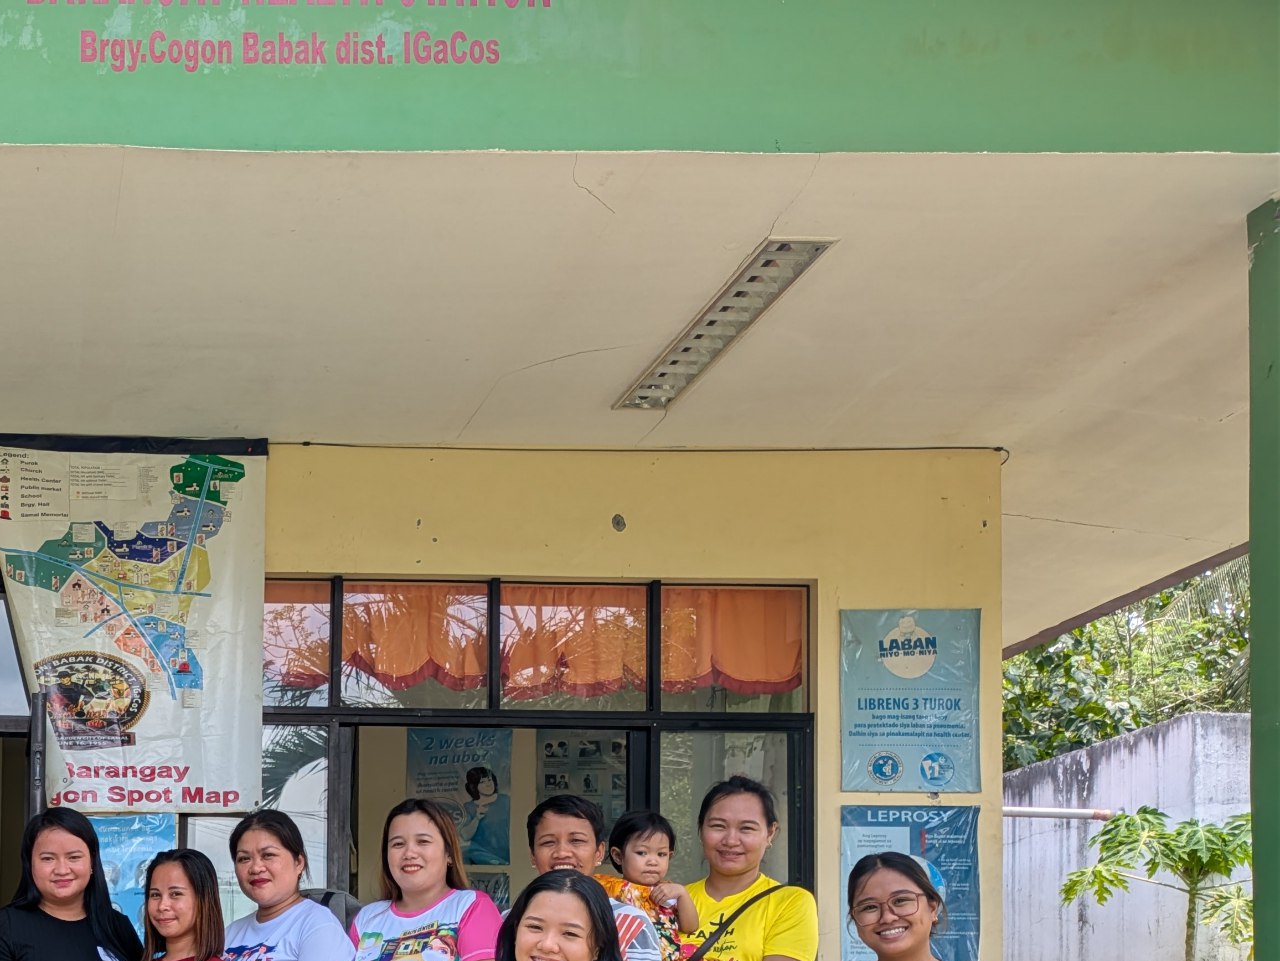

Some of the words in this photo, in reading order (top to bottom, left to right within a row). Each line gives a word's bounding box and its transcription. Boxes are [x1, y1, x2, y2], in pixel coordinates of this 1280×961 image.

[243, 32, 326, 65] Babak
[336, 31, 393, 65] dist.
[404, 31, 500, 65] IGaCos
[879, 636, 937, 652] LABAN
[52, 656, 93, 667] BABAK
[858, 698, 909, 710] LIBRENG
[912, 698, 919, 710] 3
[921, 698, 961, 711] TUROK
[424, 737, 435, 751] 2
[440, 732, 496, 750] weeks
[429, 755, 448, 765] na
[452, 750, 489, 764] ubo?
[107, 786, 172, 806] Spot
[182, 786, 240, 807] Map
[867, 810, 949, 822] LEPROSY
